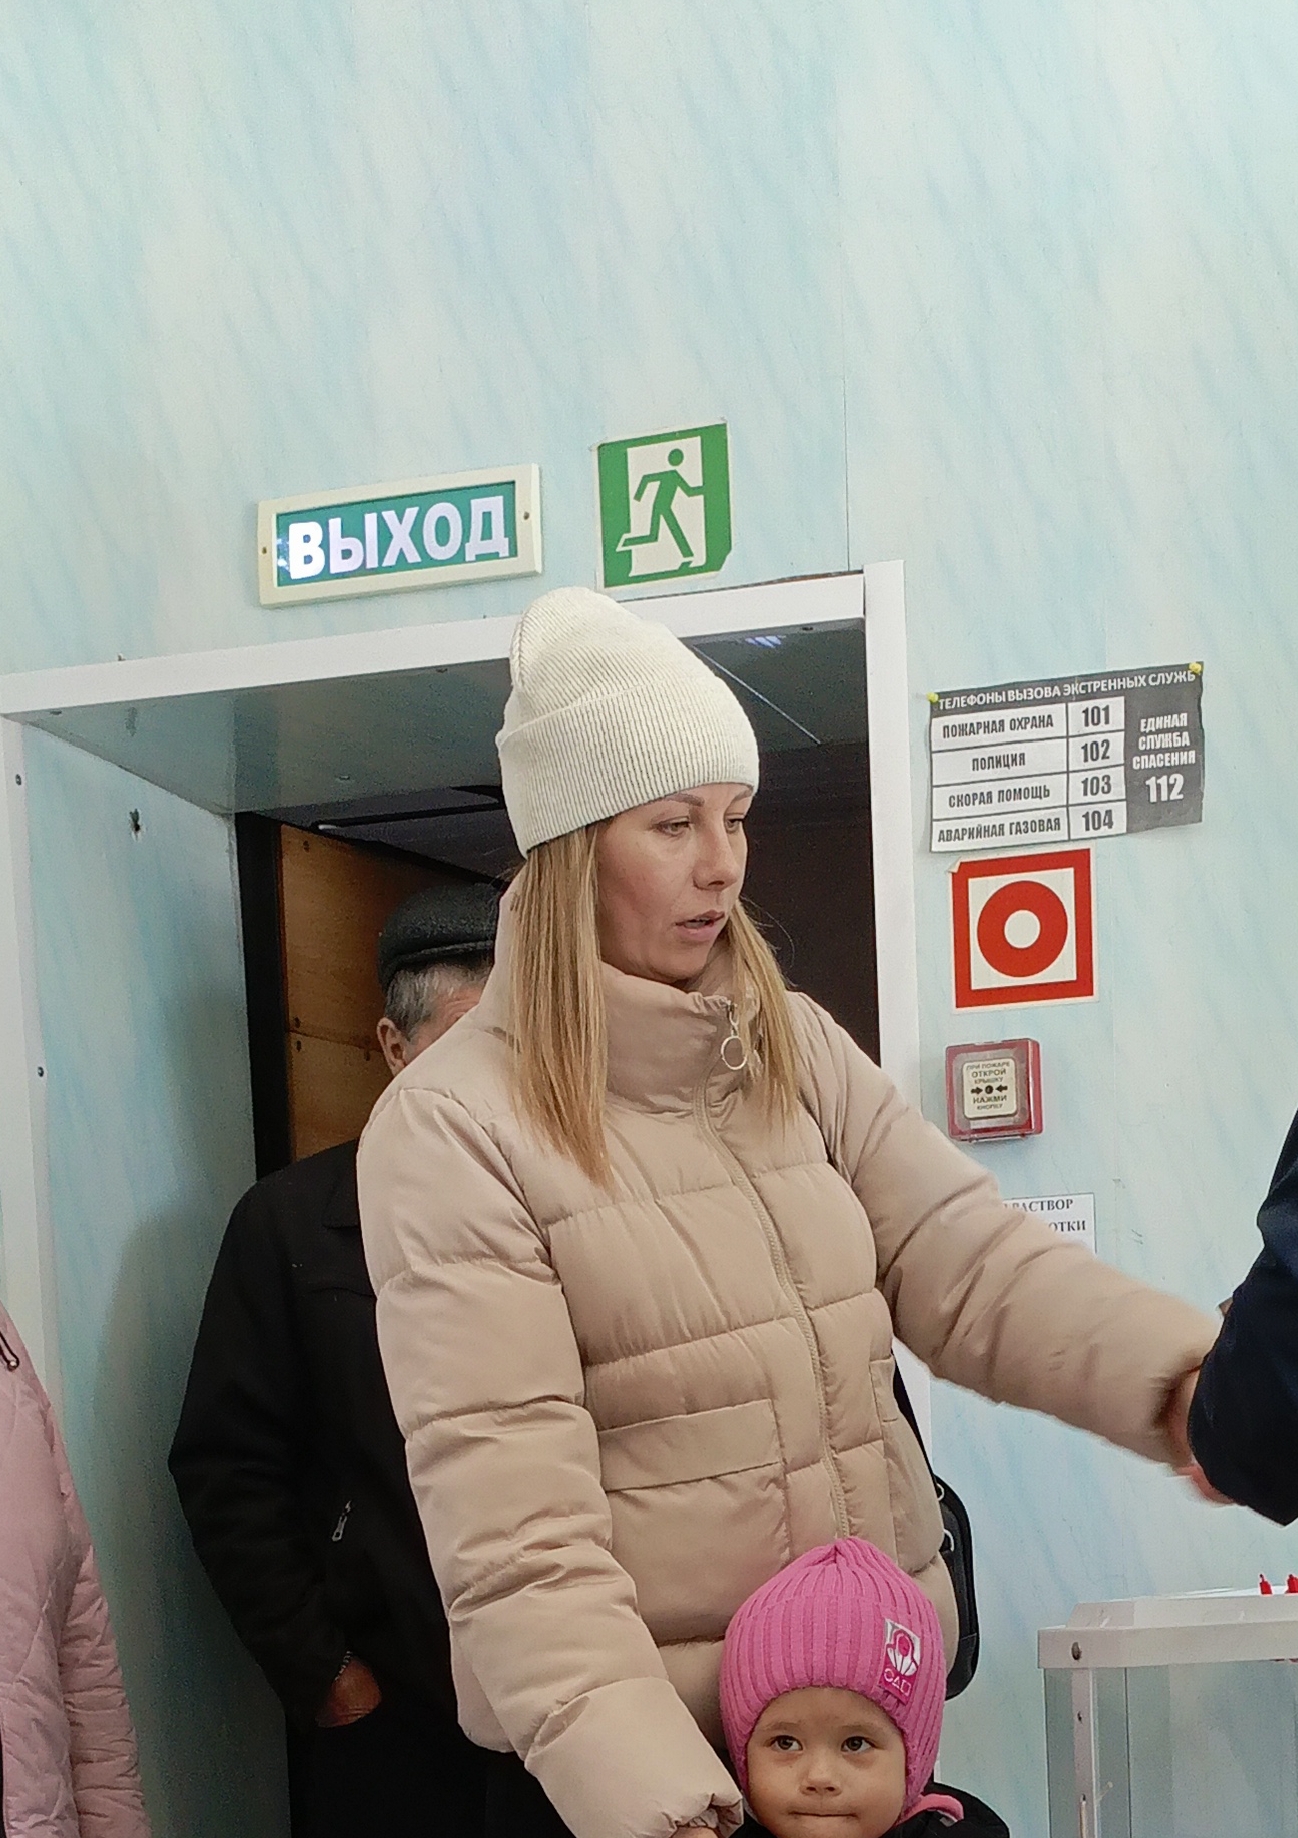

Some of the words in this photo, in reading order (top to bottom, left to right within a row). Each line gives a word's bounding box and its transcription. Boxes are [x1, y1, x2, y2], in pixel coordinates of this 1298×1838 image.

[289, 495, 509, 580] ВЫХОД
[939, 690, 1007, 710] ТЕЛЕФОНЫ
[1007, 685, 1061, 702] ВЫЗОВА
[1063, 675, 1146, 697] ЭКСТРЕННЫХ
[1148, 670, 1197, 686] СЛУЖБ
[942, 719, 1005, 739] ПОЖАРНАЯ
[1009, 714, 1054, 731] ОХРАНА
[1081, 704, 1111, 728] 101
[1140, 712, 1189, 733] ЕДИНАЯ
[1081, 738, 1111, 763] 102
[1138, 731, 1191, 751] СЛУЖБА
[972, 752, 1026, 772] ПОЛИЦИЯ
[1132, 750, 1196, 770] СПАСЕНИЯ
[948, 790, 994, 809] СКОРАЯ
[997, 784, 1051, 803] ПОМОЩЬ
[1081, 774, 1112, 797] 103
[1145, 773, 1185, 804] 112
[938, 823, 1005, 843] АВАРИЙНАЯ
[1009, 817, 1062, 836] ГАЗОВАЯ
[1081, 809, 1114, 832] 104
[971, 1068, 1006, 1078] ОТКРОЙ
[973, 1095, 1007, 1104] НАЖМИ
